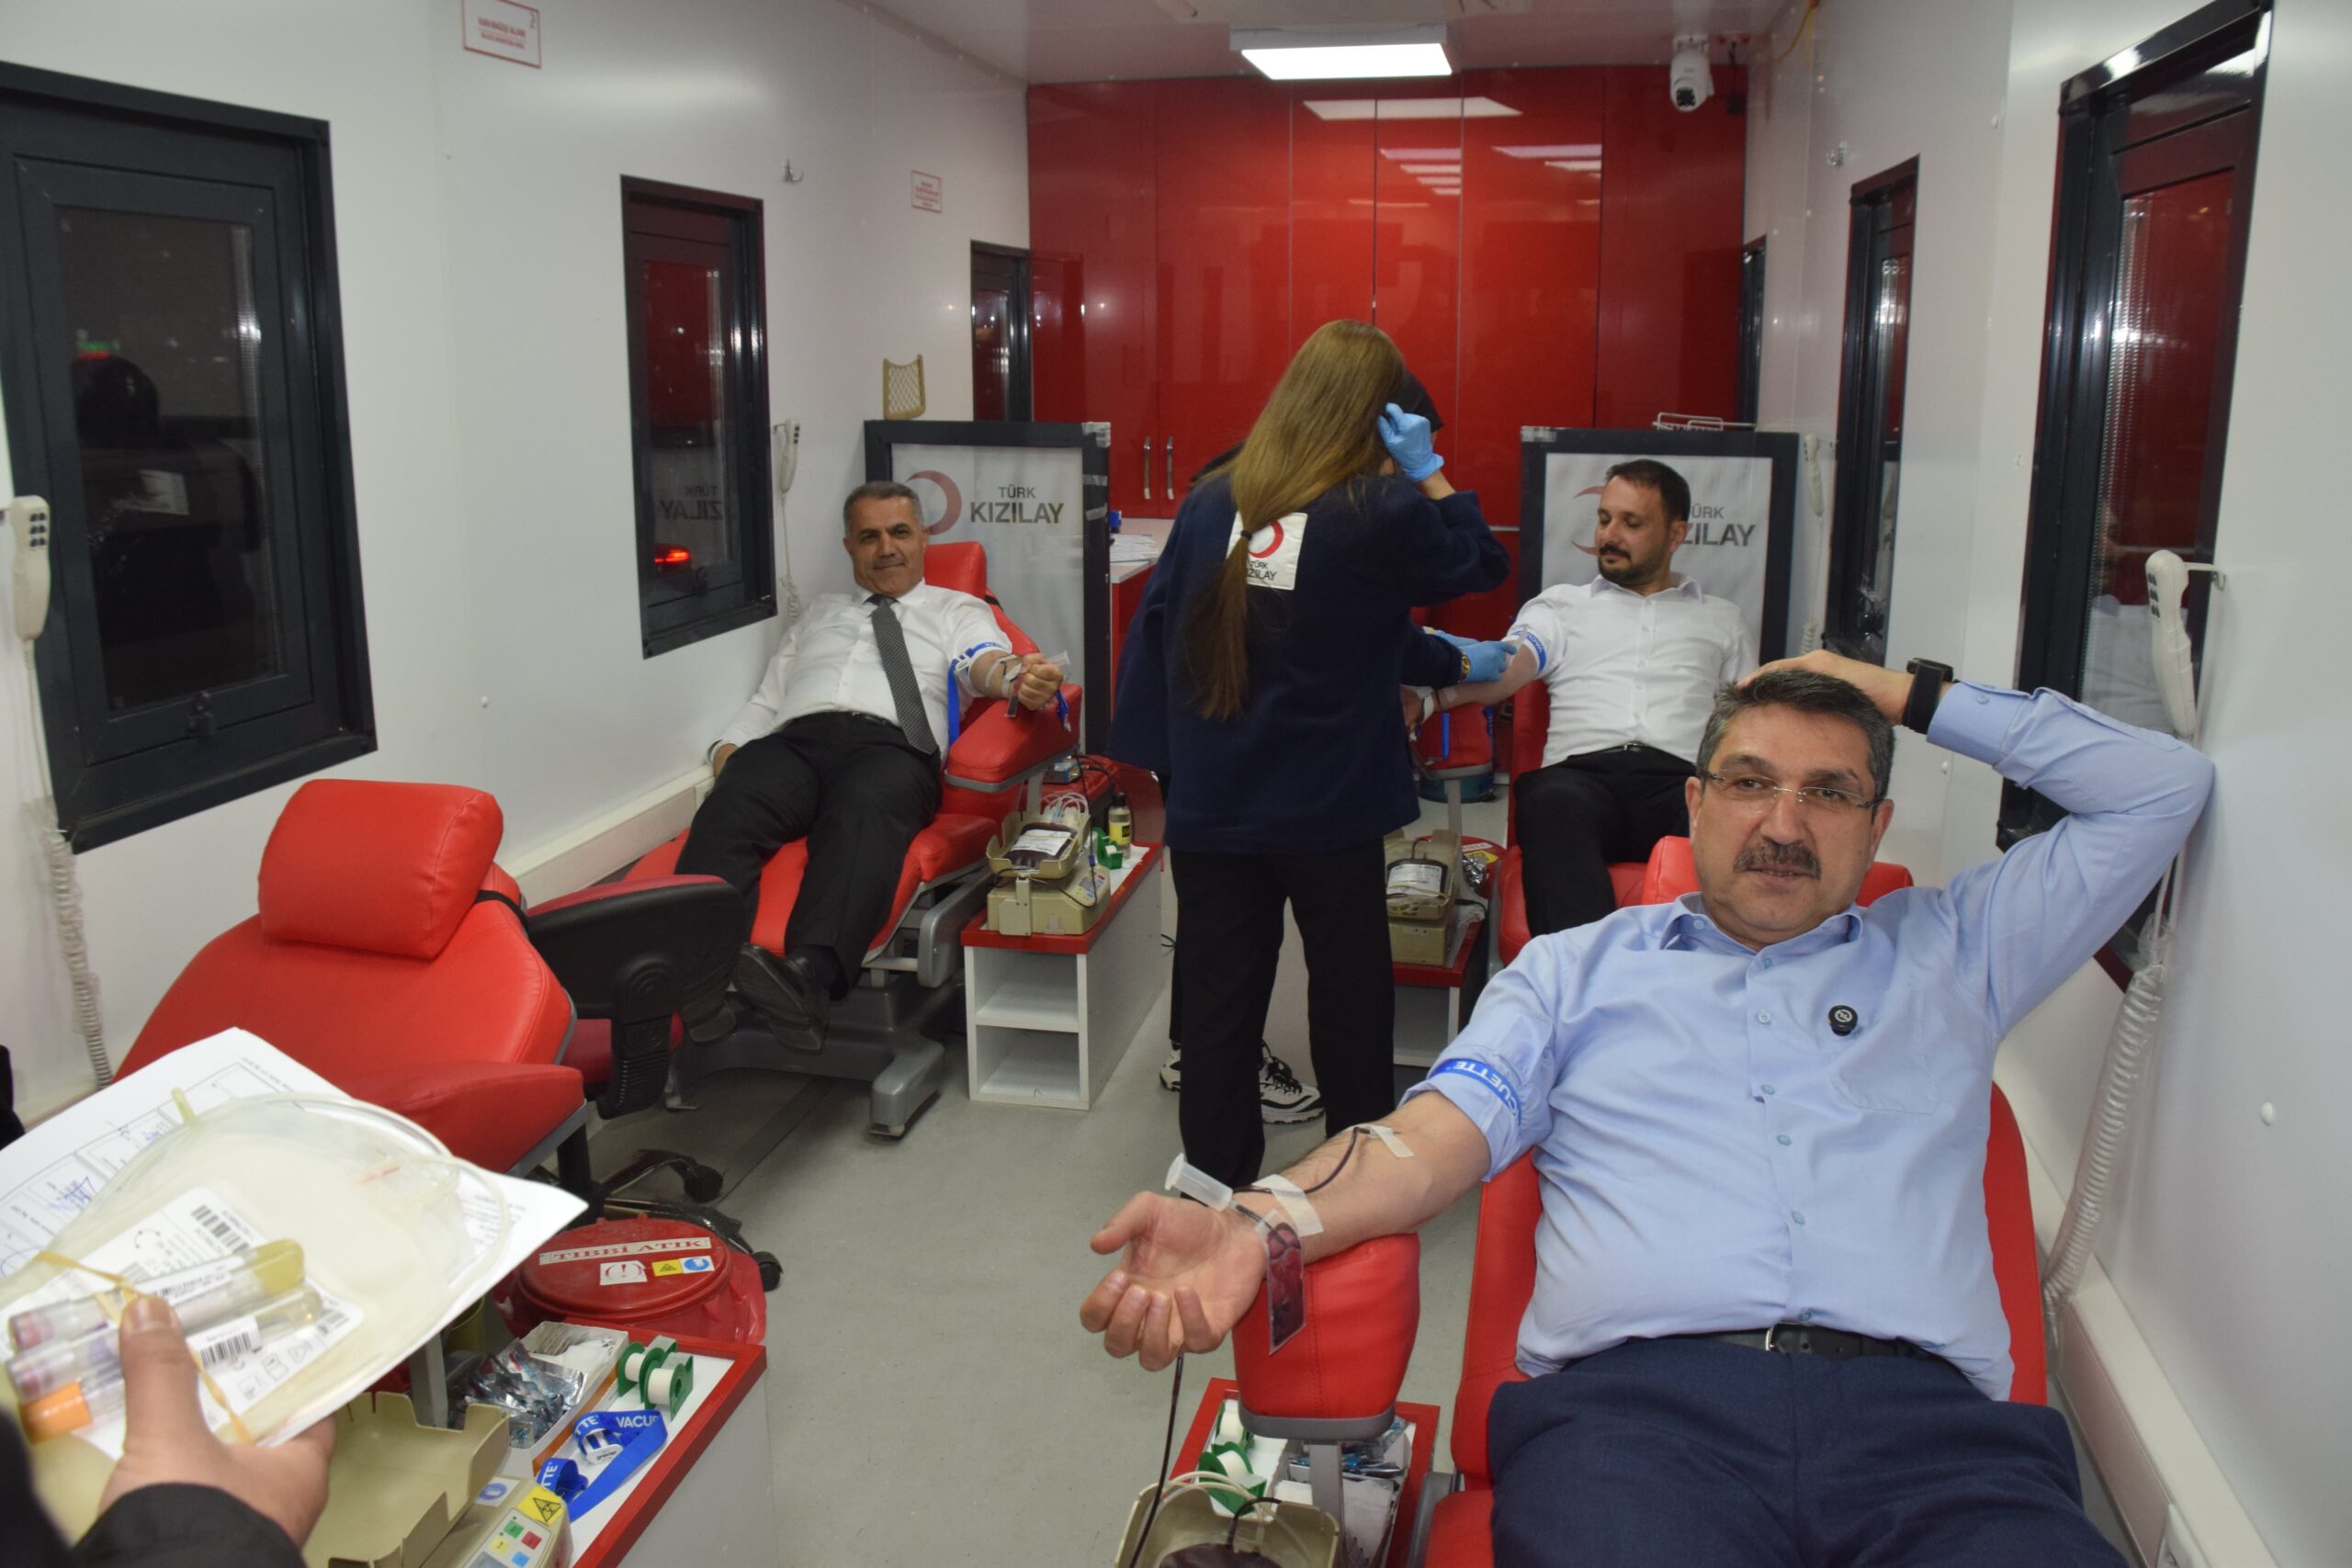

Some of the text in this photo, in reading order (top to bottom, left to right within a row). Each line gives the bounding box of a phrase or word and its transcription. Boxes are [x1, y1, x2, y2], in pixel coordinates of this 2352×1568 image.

[998, 484, 1035, 499] TÜRK
[970, 502, 1064, 525] KIZILAY
[1690, 502, 1725, 520] ÜRK
[1248, 568, 1277, 581] ZILAY
[1453, 1060, 1518, 1115] CUETTE
[638, 1240, 703, 1253] ATIK
[575, 1416, 599, 1435] TTE
[541, 1464, 559, 1487] TTE
